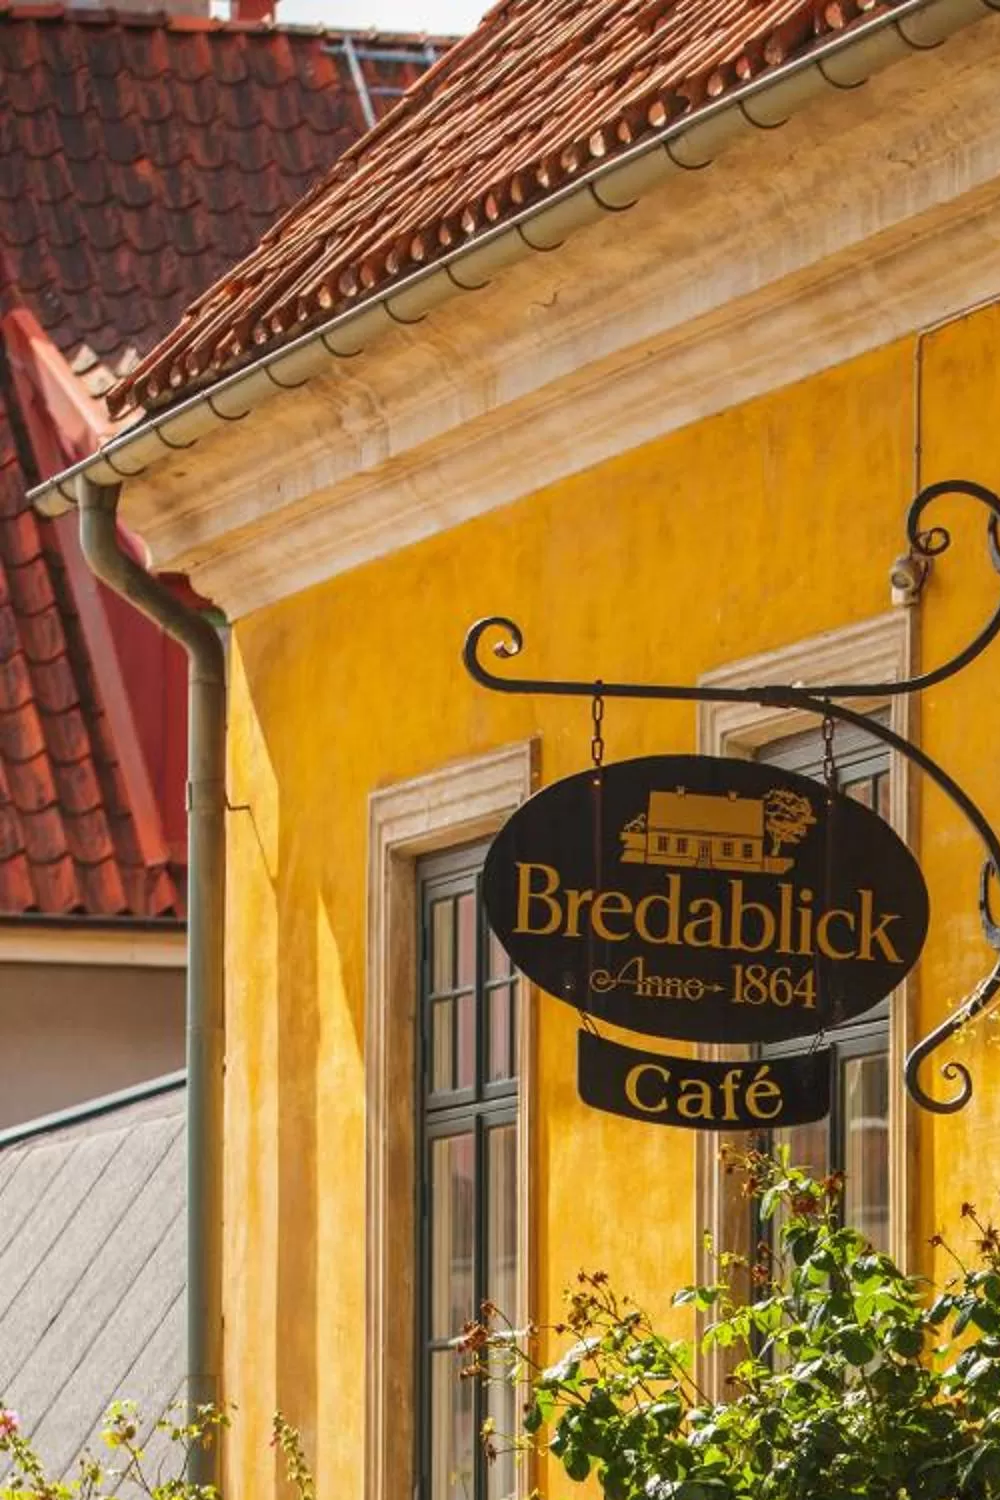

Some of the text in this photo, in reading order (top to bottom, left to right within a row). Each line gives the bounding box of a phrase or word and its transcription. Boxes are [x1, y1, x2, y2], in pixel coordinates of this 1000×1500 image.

[512, 861, 905, 965] Bredablick
[588, 956, 817, 1009] Anno 1864
[624, 1063, 784, 1122] Café
